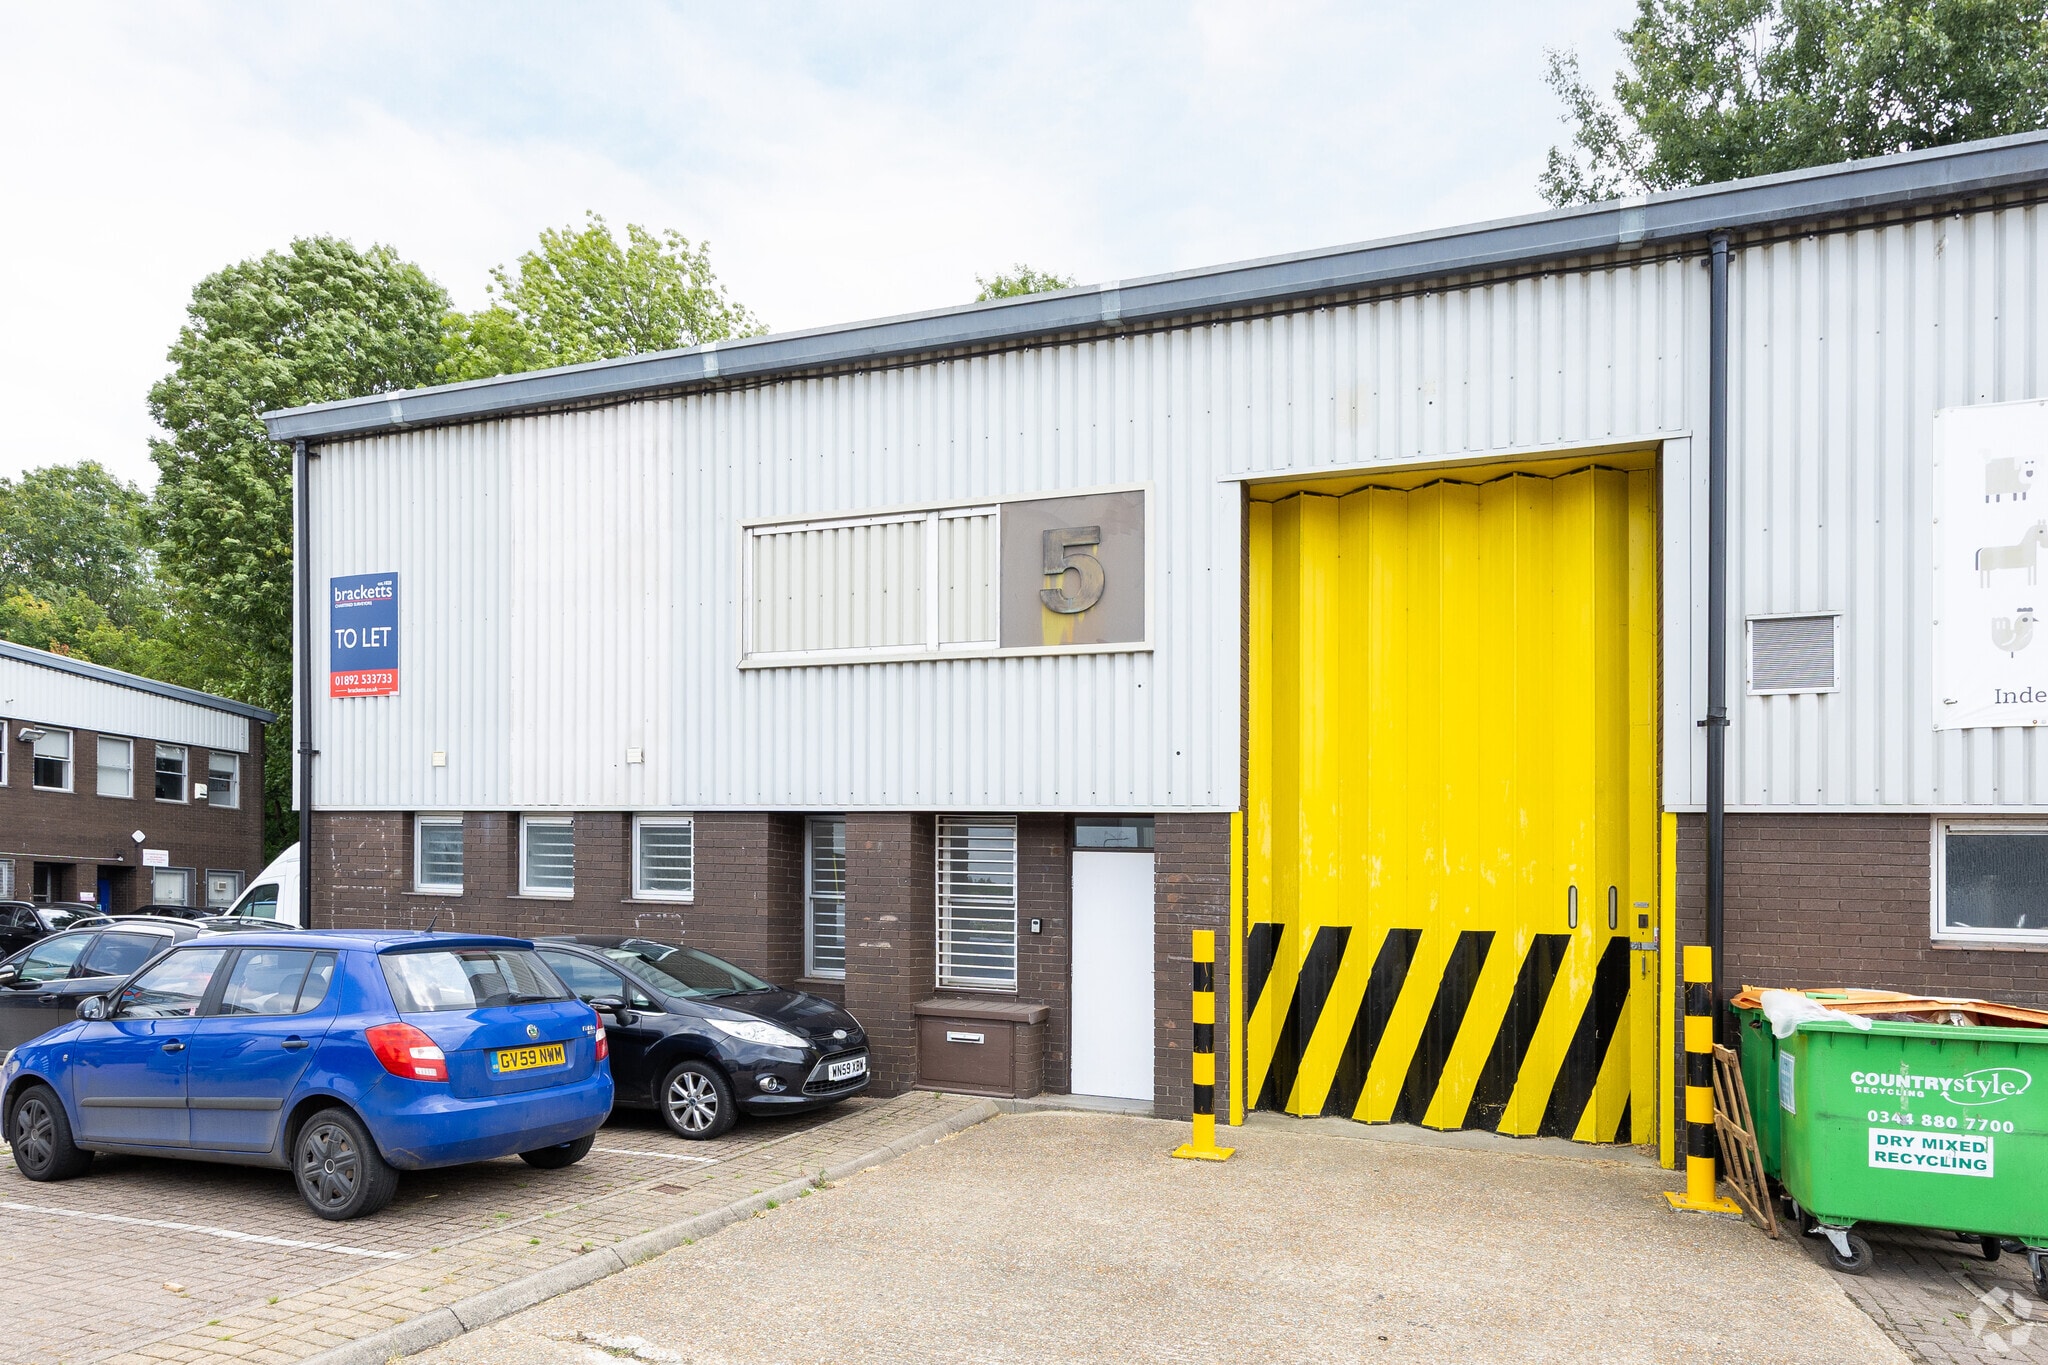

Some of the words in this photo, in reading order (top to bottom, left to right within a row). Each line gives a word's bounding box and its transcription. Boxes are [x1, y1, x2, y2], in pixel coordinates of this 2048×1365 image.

[1040, 525, 1105, 614] 5
[334, 584, 393, 602] bracketts
[335, 628, 357, 649] TO
[362, 626, 392, 647] LET
[335, 675, 359, 686] 01892
[361, 673, 393, 684] 533733
[1994, 686, 2048, 704] Inde
[500, 1050, 537, 1069] GV59
[540, 1046, 563, 1064] NWM
[832, 1062, 851, 1078] WN59
[1855, 1086, 1925, 1098] RECYCLING
[1867, 1110, 1914, 1126] 0344
[1921, 1114, 1958, 1129] 880
[1965, 1117, 2014, 1133] 7700
[1876, 1134, 1915, 1148] DRY
[1922, 1138, 1986, 1154] MIXED
[1874, 1150, 1988, 1171] RECYCLING
